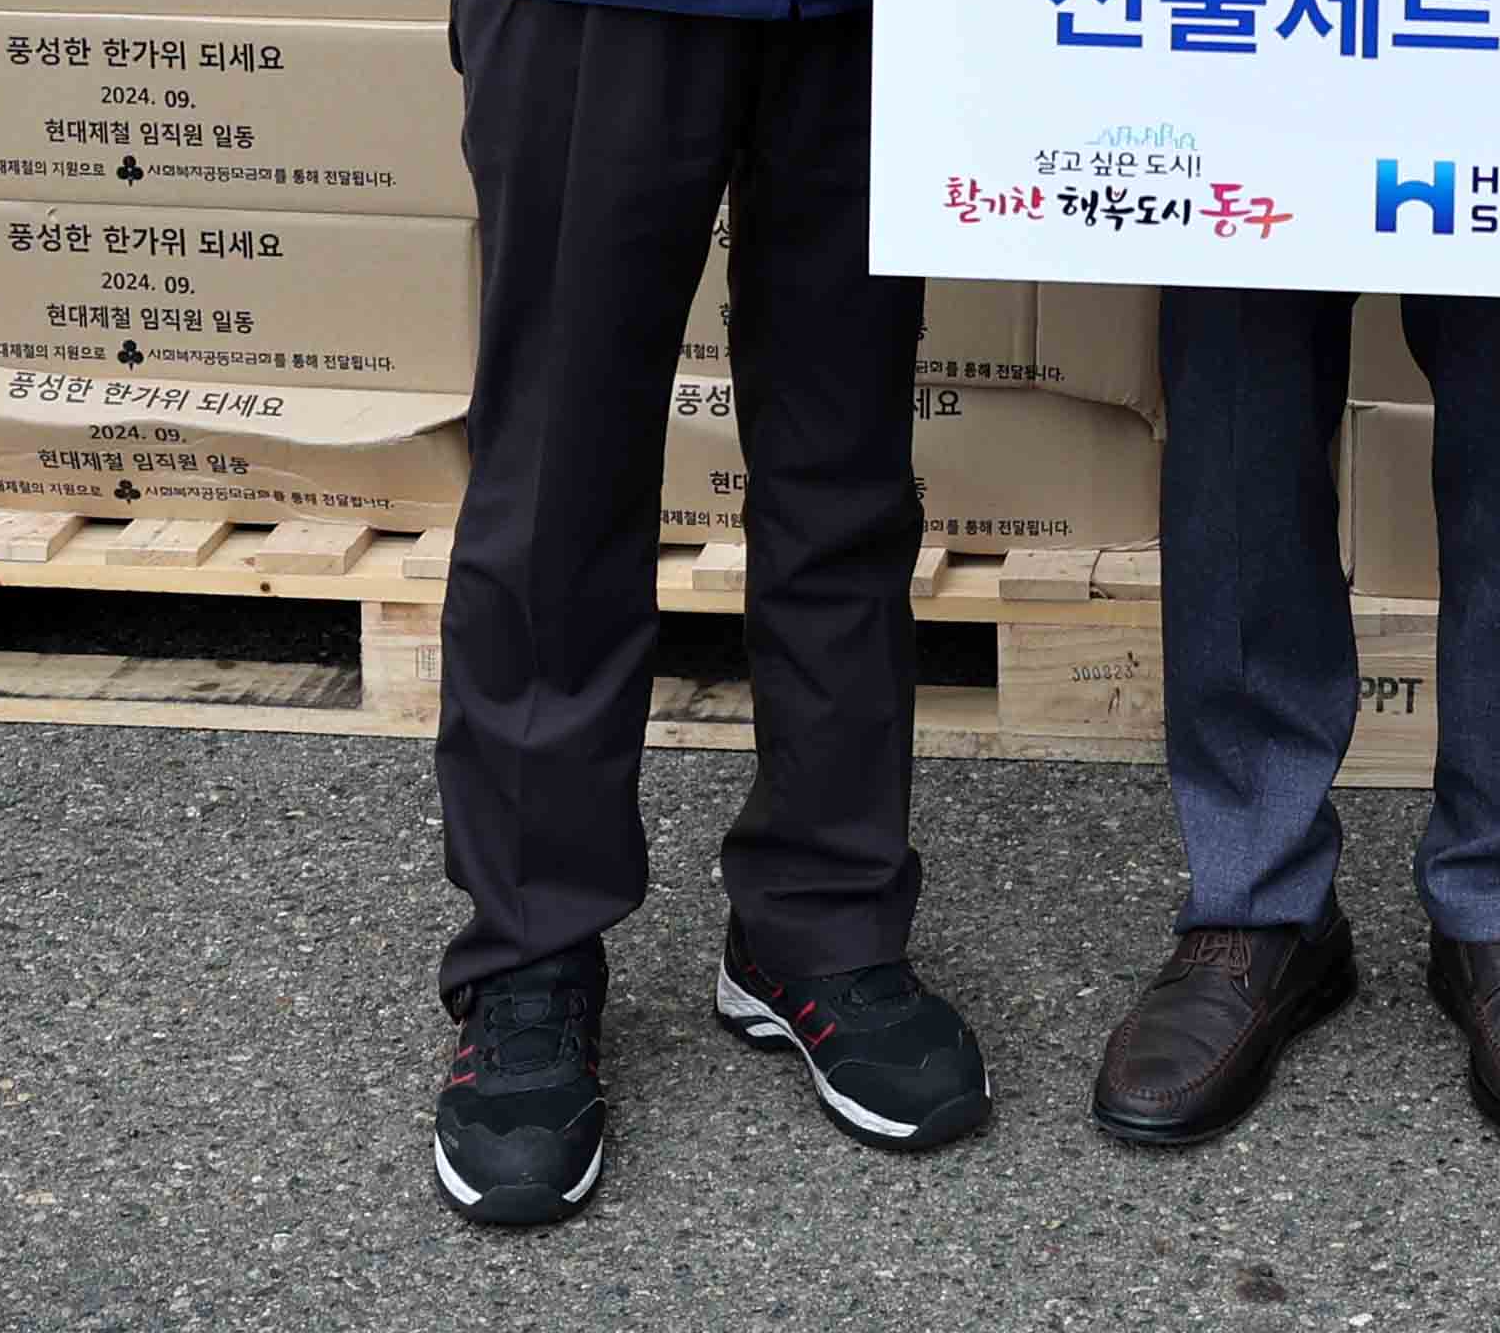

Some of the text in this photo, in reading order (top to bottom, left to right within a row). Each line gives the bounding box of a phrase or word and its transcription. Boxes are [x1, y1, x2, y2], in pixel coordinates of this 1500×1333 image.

[1035, 150, 1200, 179] 살고 싶은 도시!
[944, 171, 1293, 239] 활기찬 행복도시 동구
[1357, 675, 1424, 714] PPT
